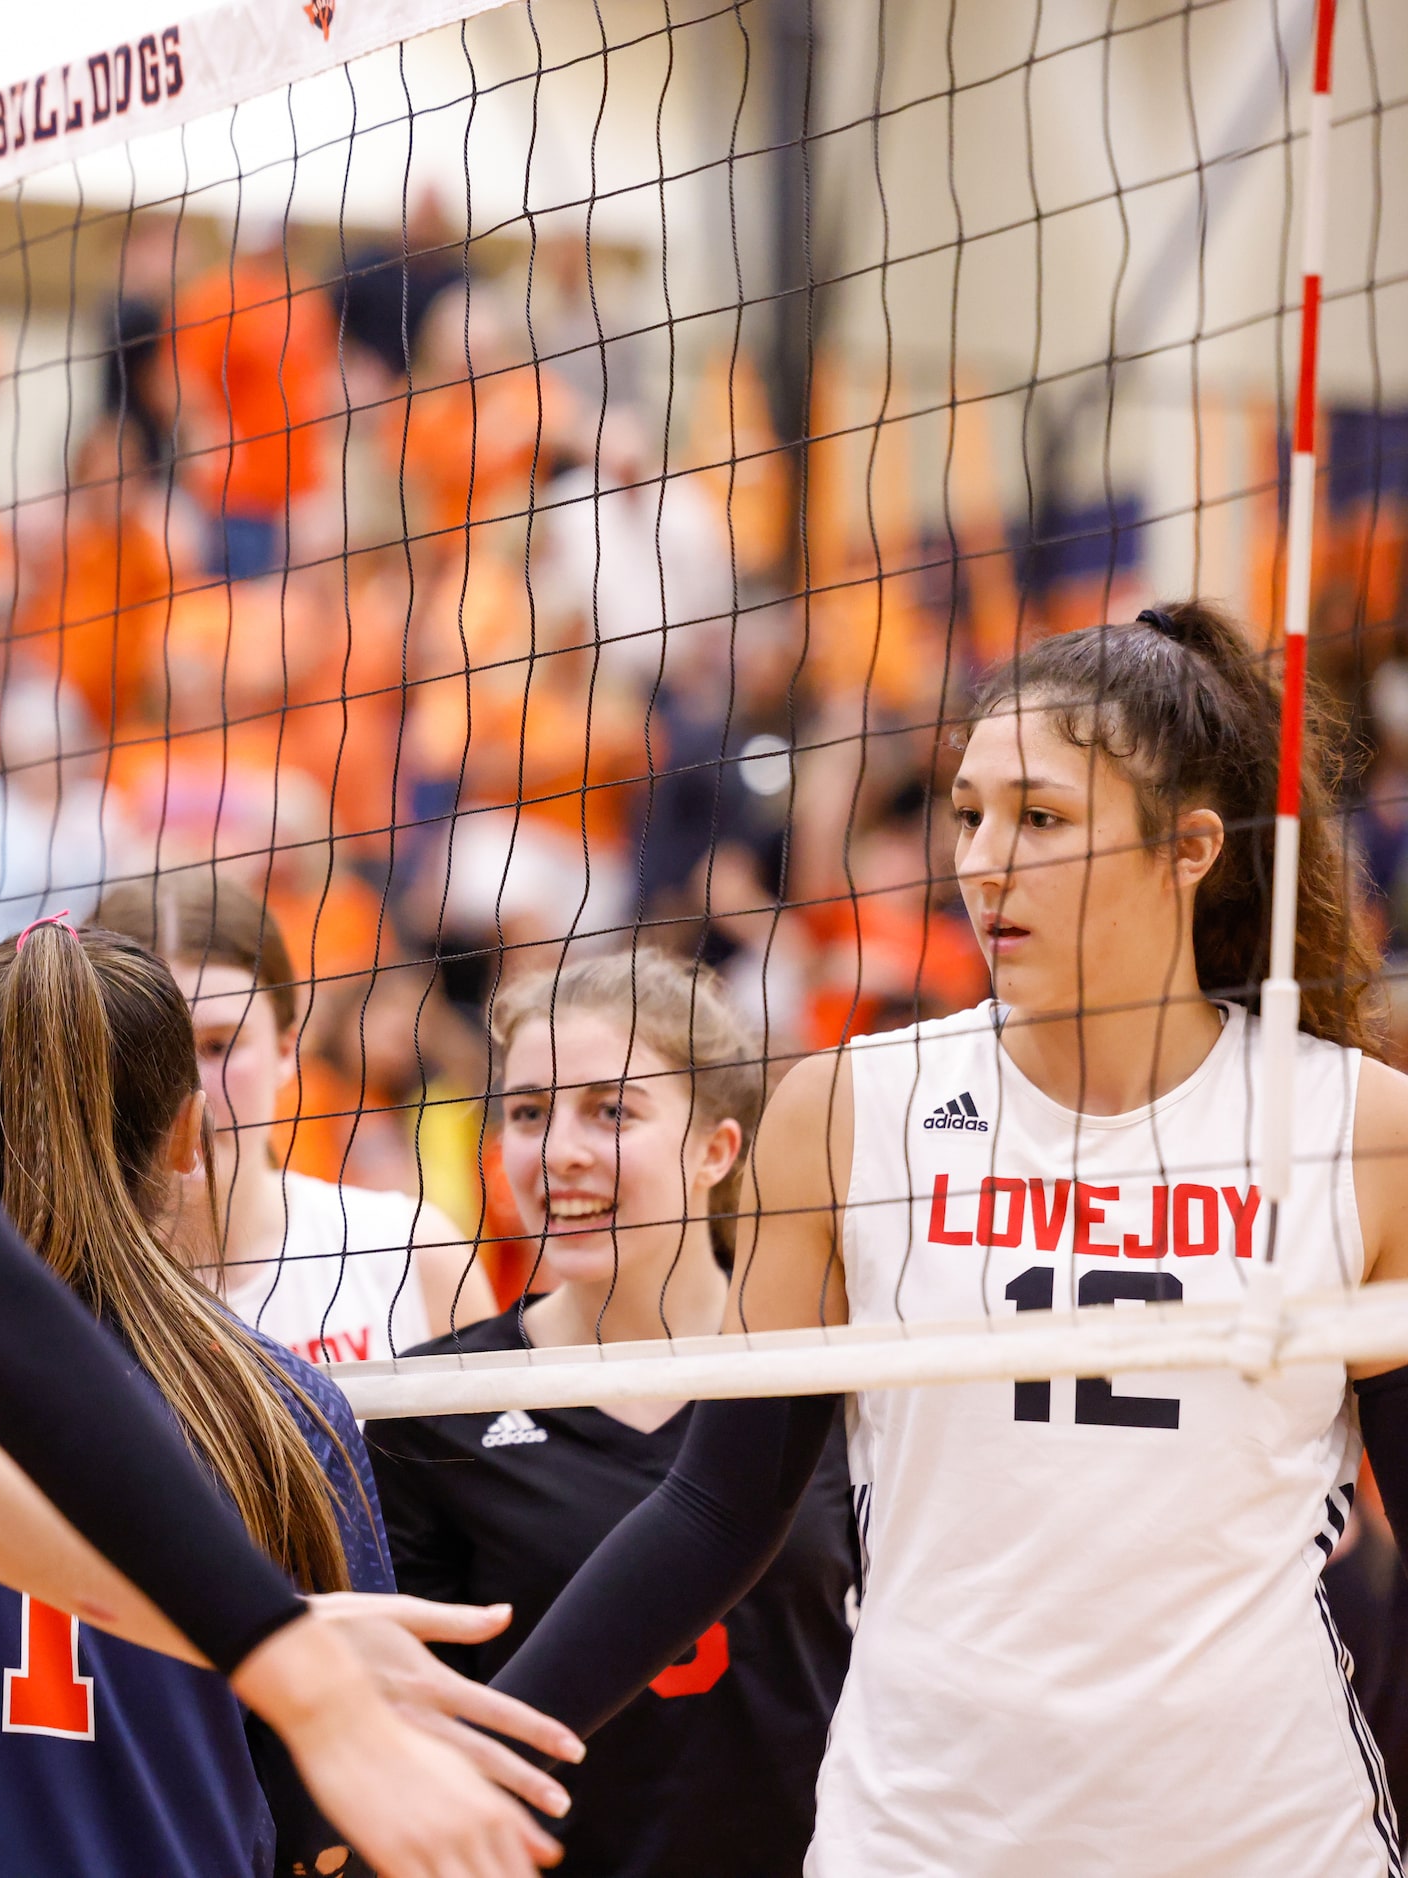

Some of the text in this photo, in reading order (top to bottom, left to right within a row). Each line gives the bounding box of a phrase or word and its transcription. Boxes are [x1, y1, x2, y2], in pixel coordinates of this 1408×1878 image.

[923, 1113, 990, 1133] adidas
[927, 1173, 1264, 1260] LOVEJOY
[1004, 1266, 1184, 1430] 12
